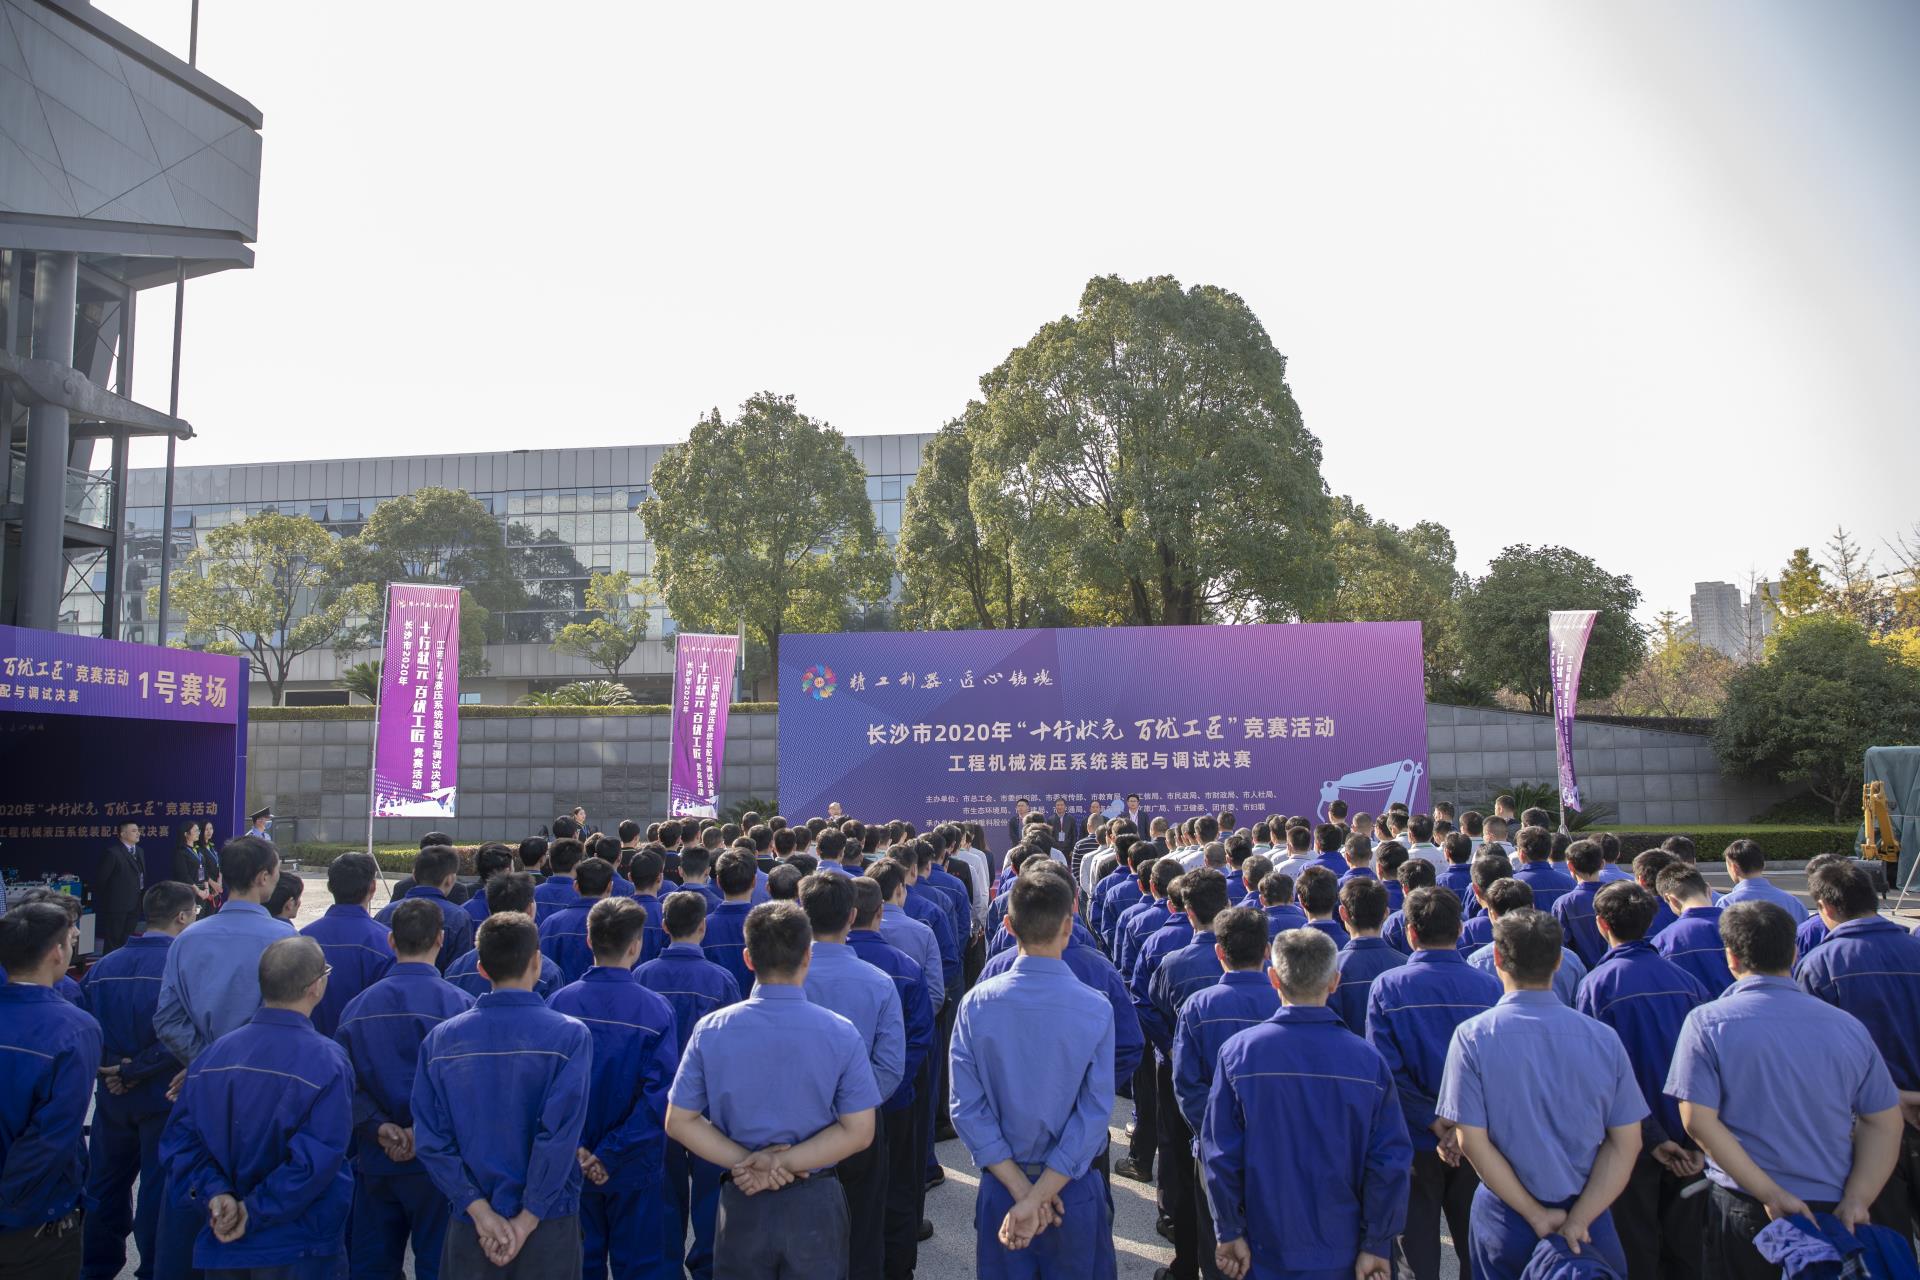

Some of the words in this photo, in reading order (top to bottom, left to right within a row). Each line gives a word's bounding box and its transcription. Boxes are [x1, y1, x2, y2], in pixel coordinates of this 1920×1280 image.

[416, 621, 431, 680] 十行状元
[138, 670, 227, 708] 1号赛场
[411, 685, 428, 743] 百优工匠
[1134, 715, 1335, 741] 百优工匠”竞赛活动
[411, 747, 425, 790] 竞赛活动
[948, 750, 1252, 772] 工程机械液压系统装配与调试决赛
